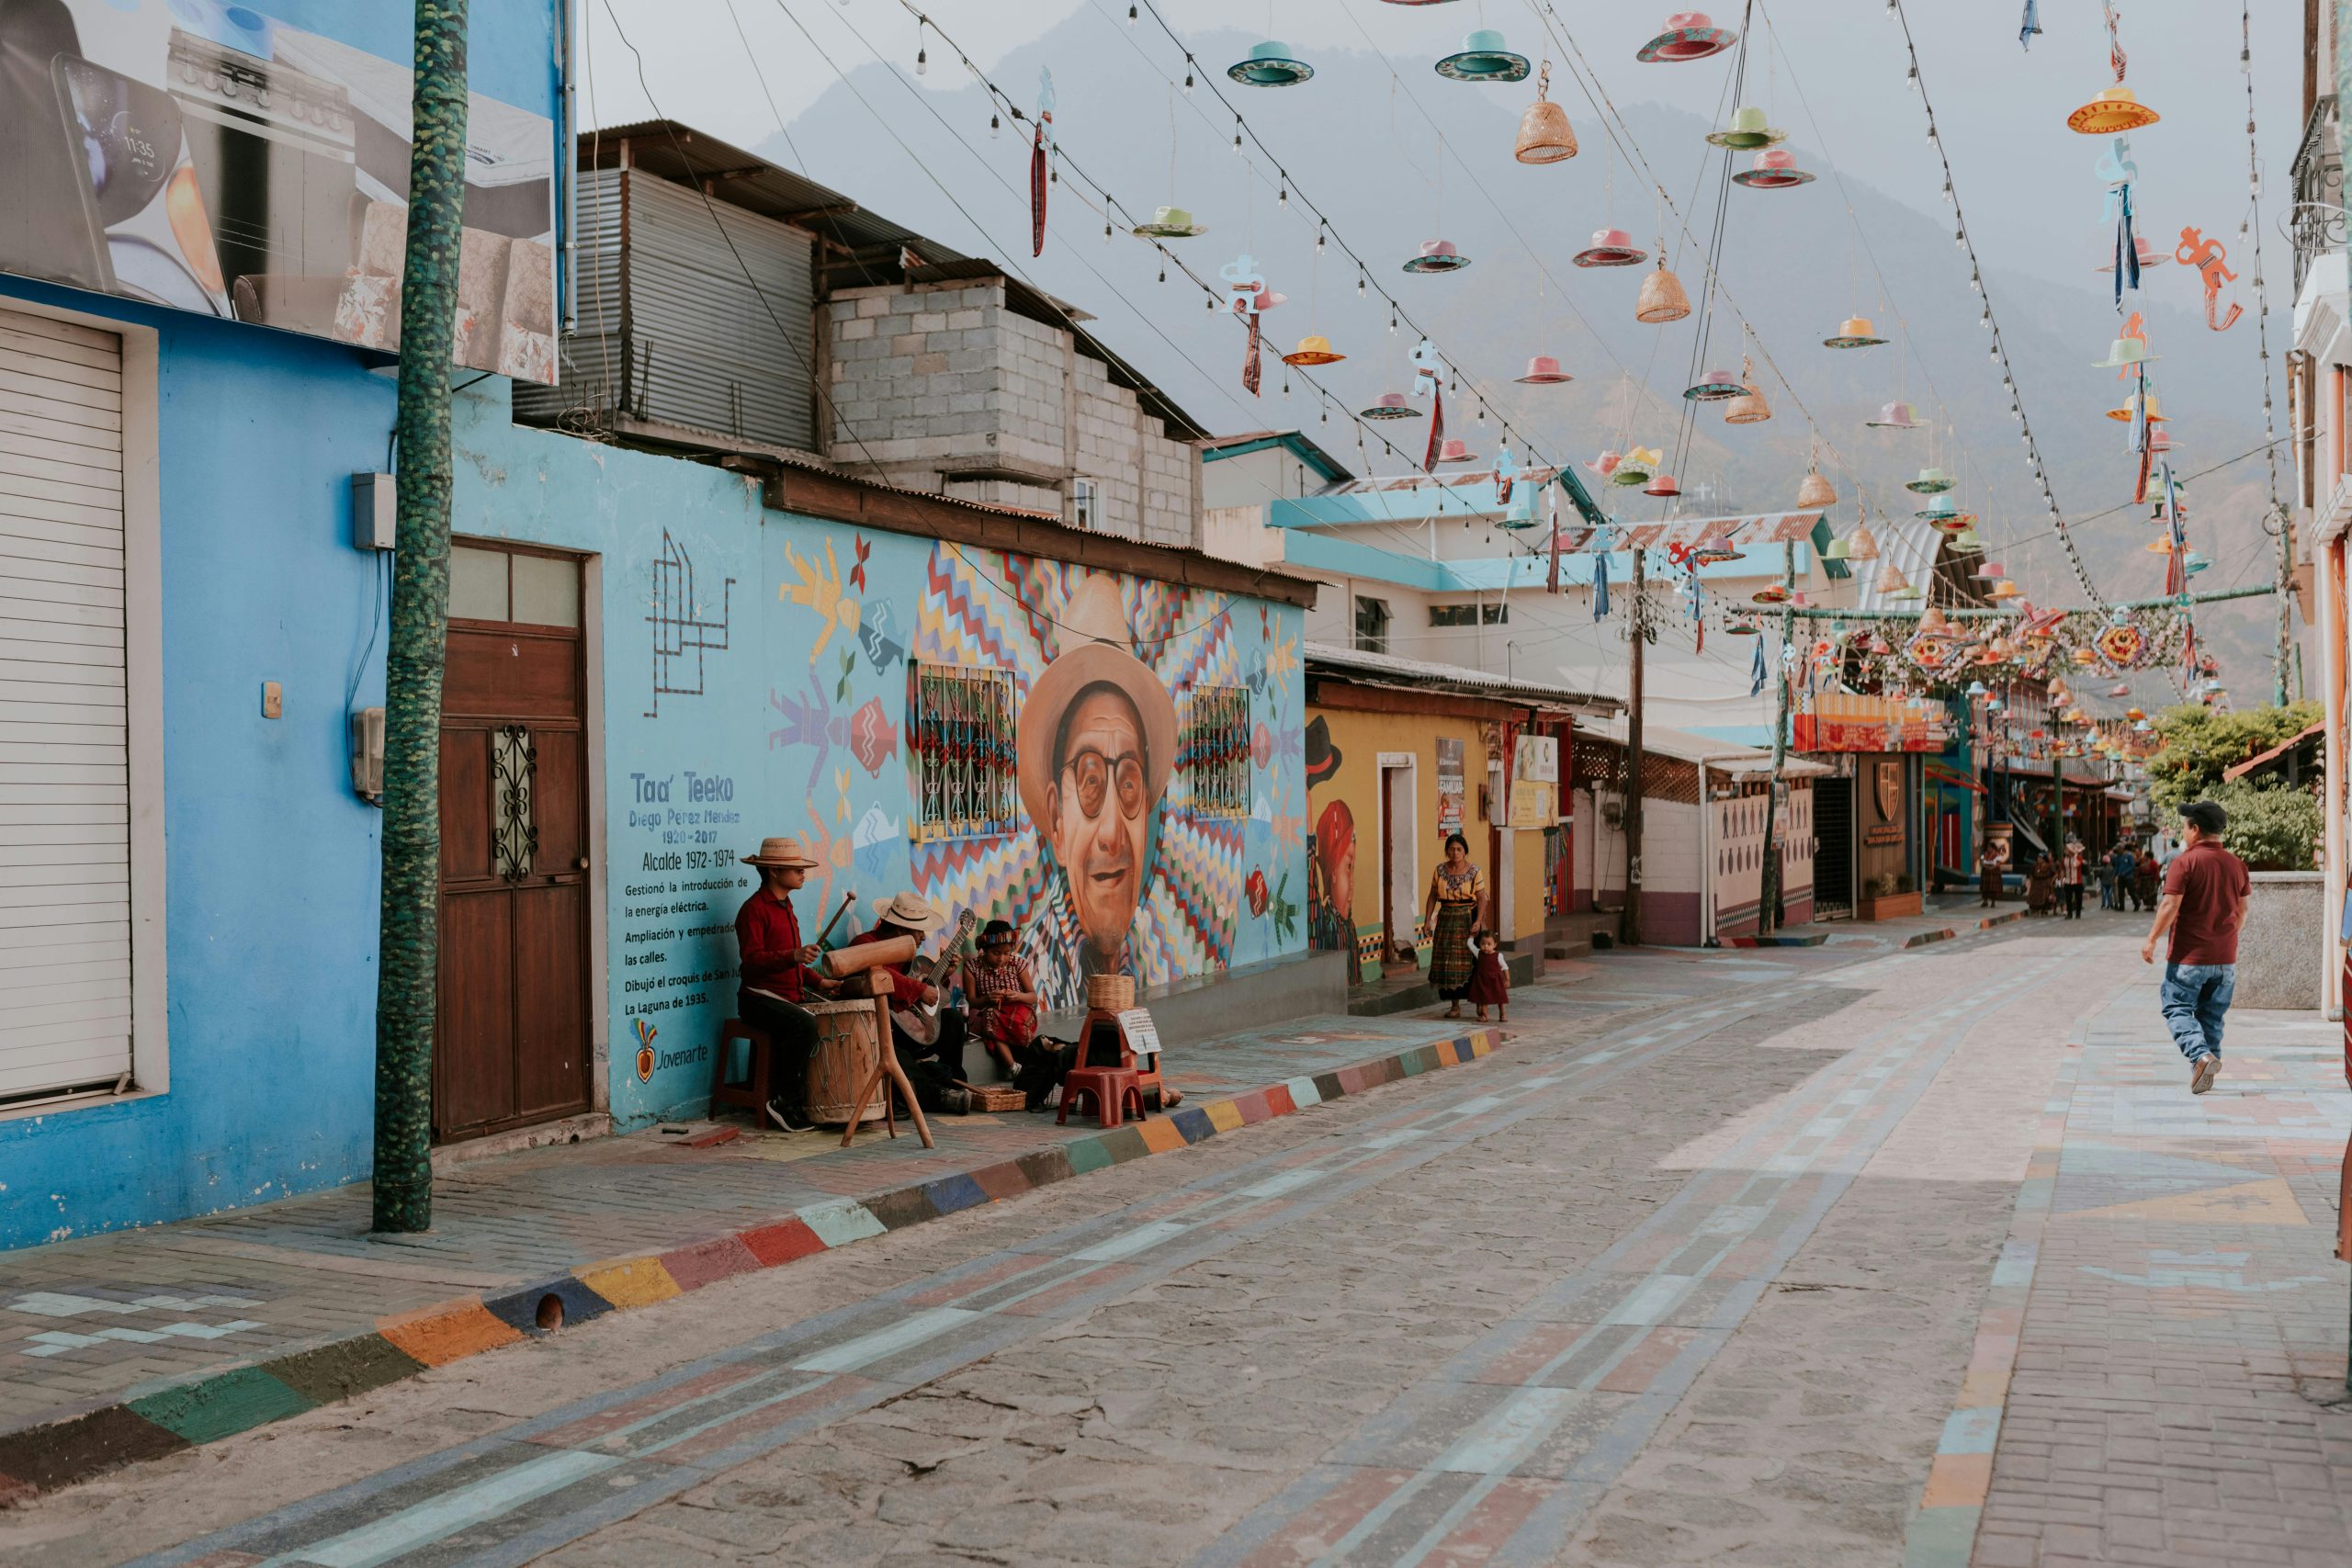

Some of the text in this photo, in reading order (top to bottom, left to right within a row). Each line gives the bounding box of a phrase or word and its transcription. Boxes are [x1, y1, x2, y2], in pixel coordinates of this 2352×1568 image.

[124, 136, 154, 158] 11:35
[684, 771, 734, 803] Teeko
[629, 810, 662, 832] Diego
[642, 852, 682, 872] Alcalde
[625, 877, 748, 897] Gestionó la introducción de
[625, 906, 633, 918] la
[671, 900, 709, 914] eléctrica.
[625, 922, 735, 944] Ampliación y empedrado
[625, 951, 668, 966] las calles.
[625, 967, 741, 992] Dibujó el croquis de San Ju
[625, 992, 709, 1016] La Laguna de 1935.
[656, 1043, 707, 1070] Jovenarte
